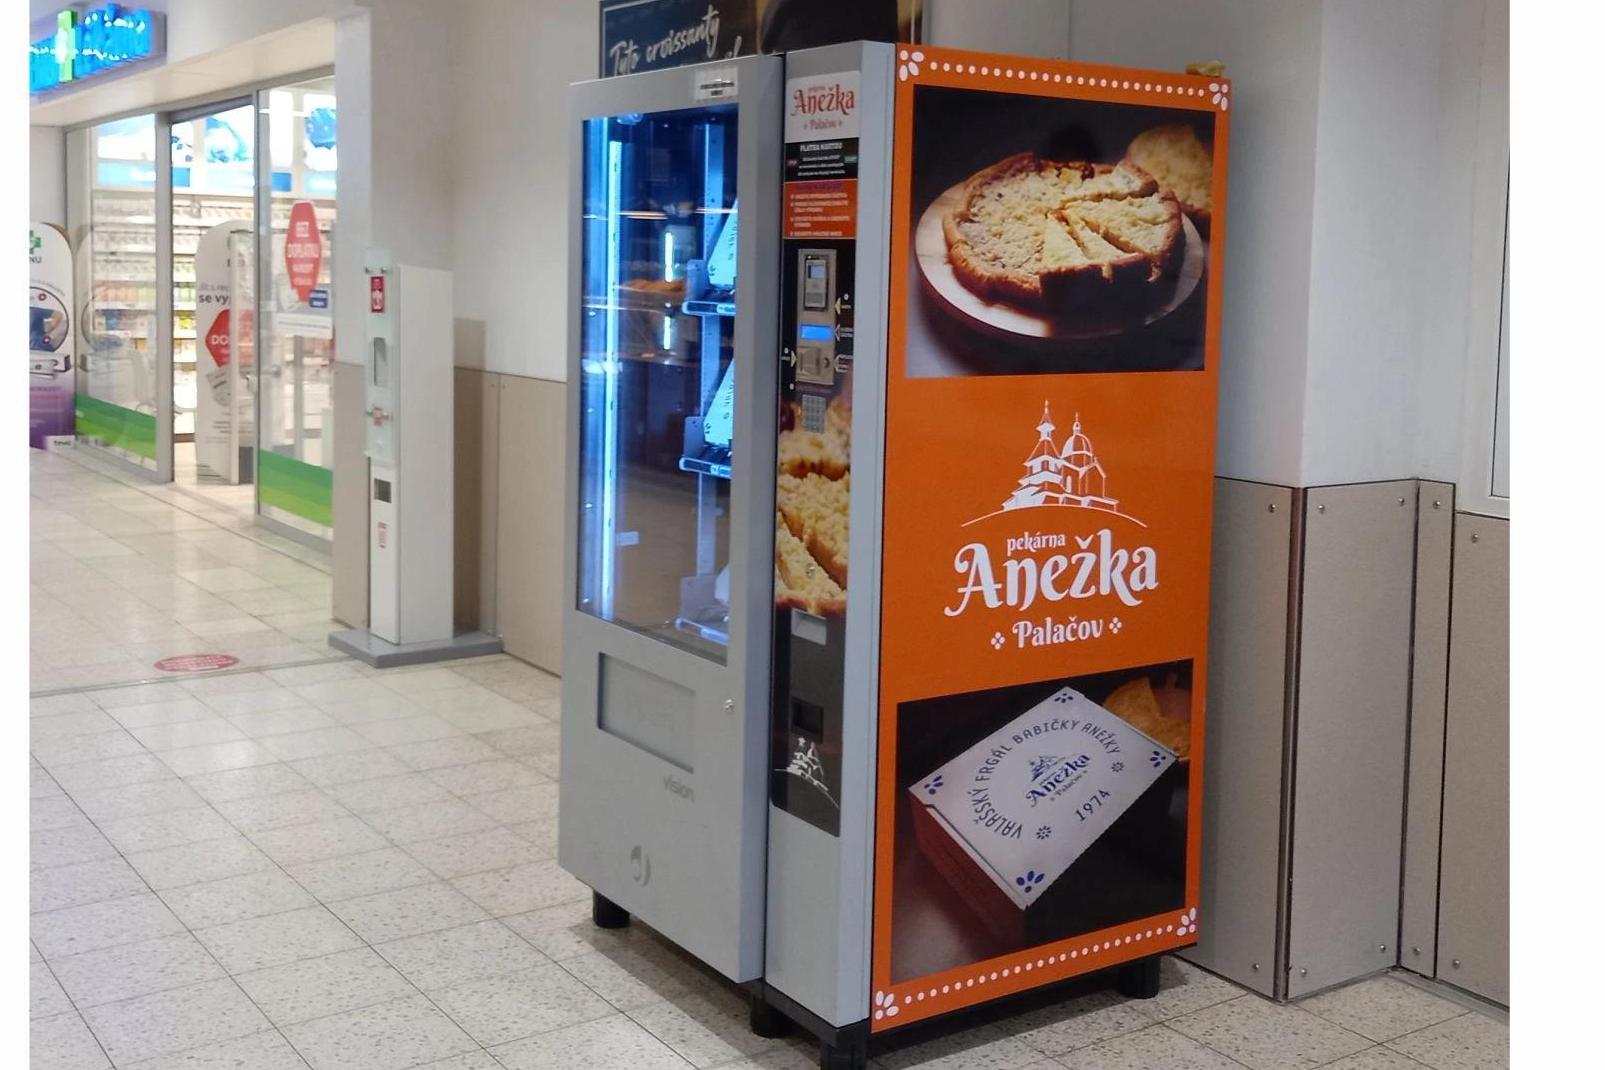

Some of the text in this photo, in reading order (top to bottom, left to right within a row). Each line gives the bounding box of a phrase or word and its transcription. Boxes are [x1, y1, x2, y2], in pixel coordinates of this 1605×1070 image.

[646, 4, 720, 63] croissanty
[790, 84, 855, 116] Anežka
[199, 295, 212, 303] se
[1007, 531, 1066, 556] pekárna
[944, 528, 1159, 617] Anežka
[1012, 616, 1104, 649] Palačov
[975, 744, 1013, 782] FRGÁL
[1012, 719, 1080, 744] BABIČKY
[1081, 722, 1121, 755] ANEŽKY
[1025, 754, 1091, 808] Anežka
[1074, 788, 1111, 823] 1974
